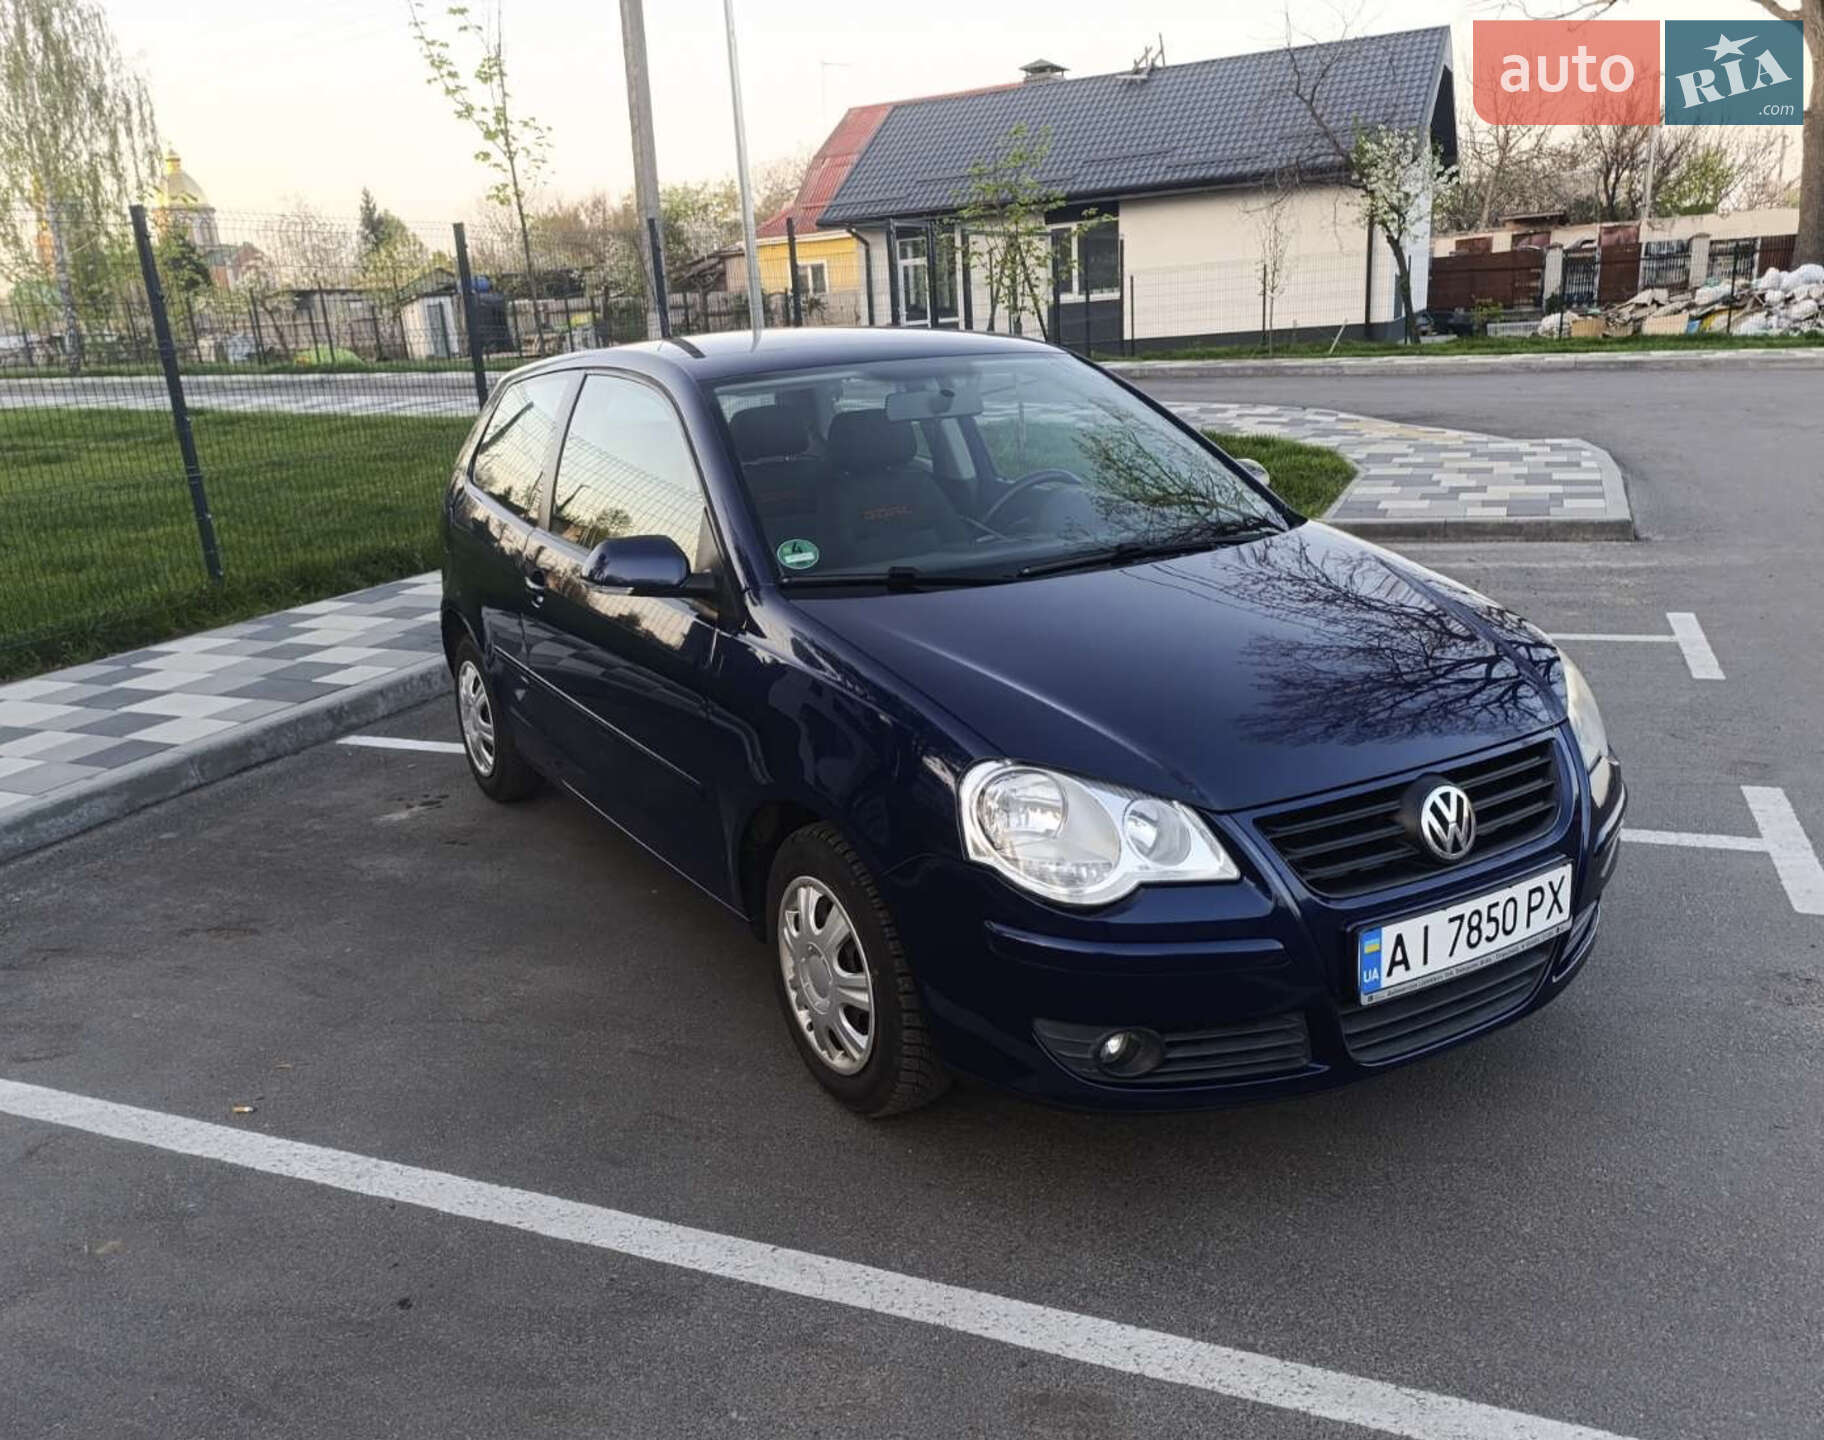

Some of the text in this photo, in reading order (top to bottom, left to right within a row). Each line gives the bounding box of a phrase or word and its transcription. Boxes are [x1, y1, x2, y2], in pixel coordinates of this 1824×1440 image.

[1447, 897, 1518, 958] 7850
[1526, 875, 1566, 929] PX
[1363, 969, 1379, 983] UA
